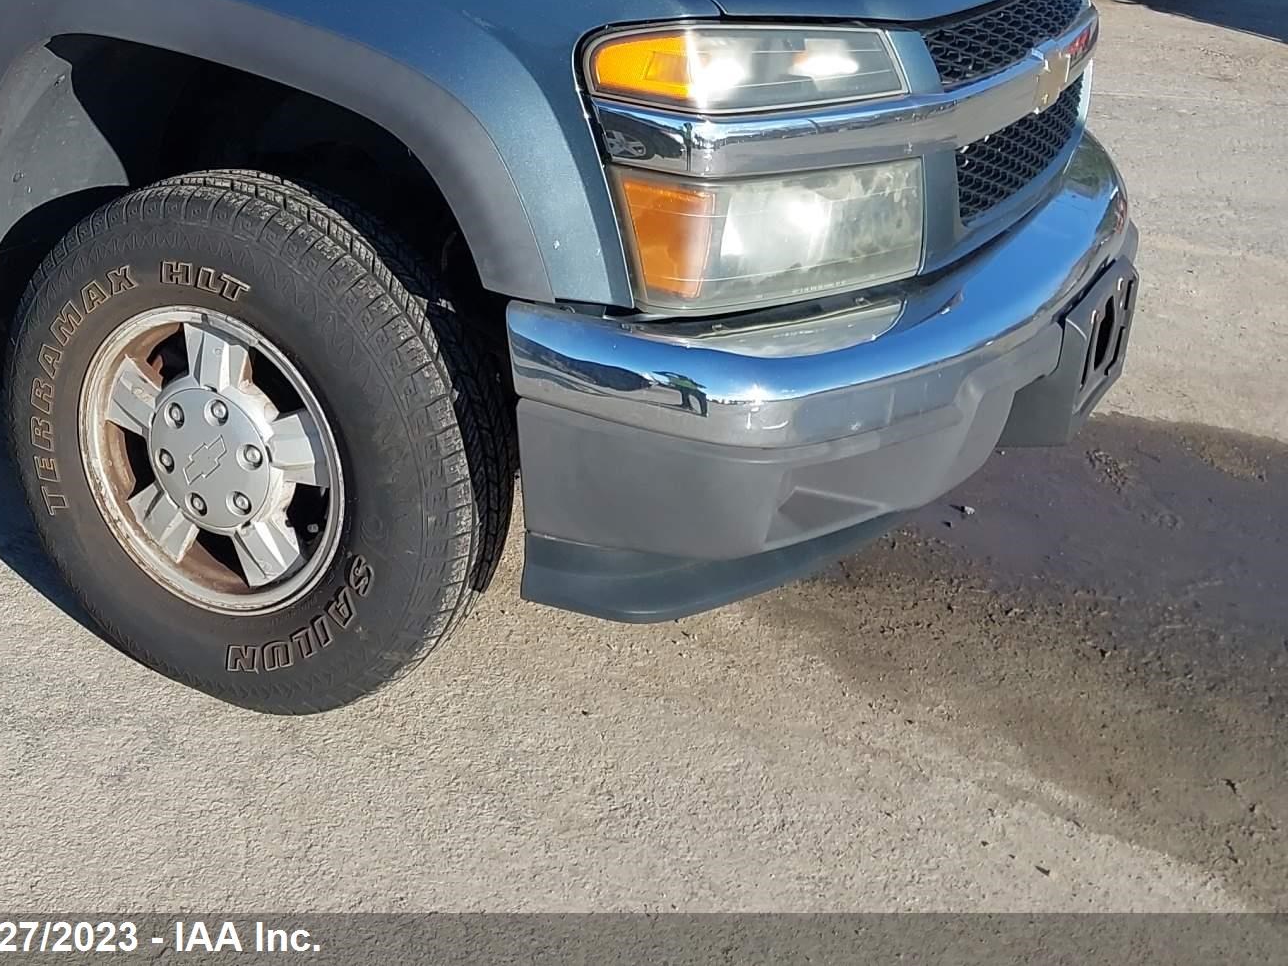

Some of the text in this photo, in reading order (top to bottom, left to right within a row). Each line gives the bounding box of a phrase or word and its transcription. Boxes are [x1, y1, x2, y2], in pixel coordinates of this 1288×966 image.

[30, 260, 252, 516] TERRAMAX HLT
[226, 553, 375, 674] SAILUN
